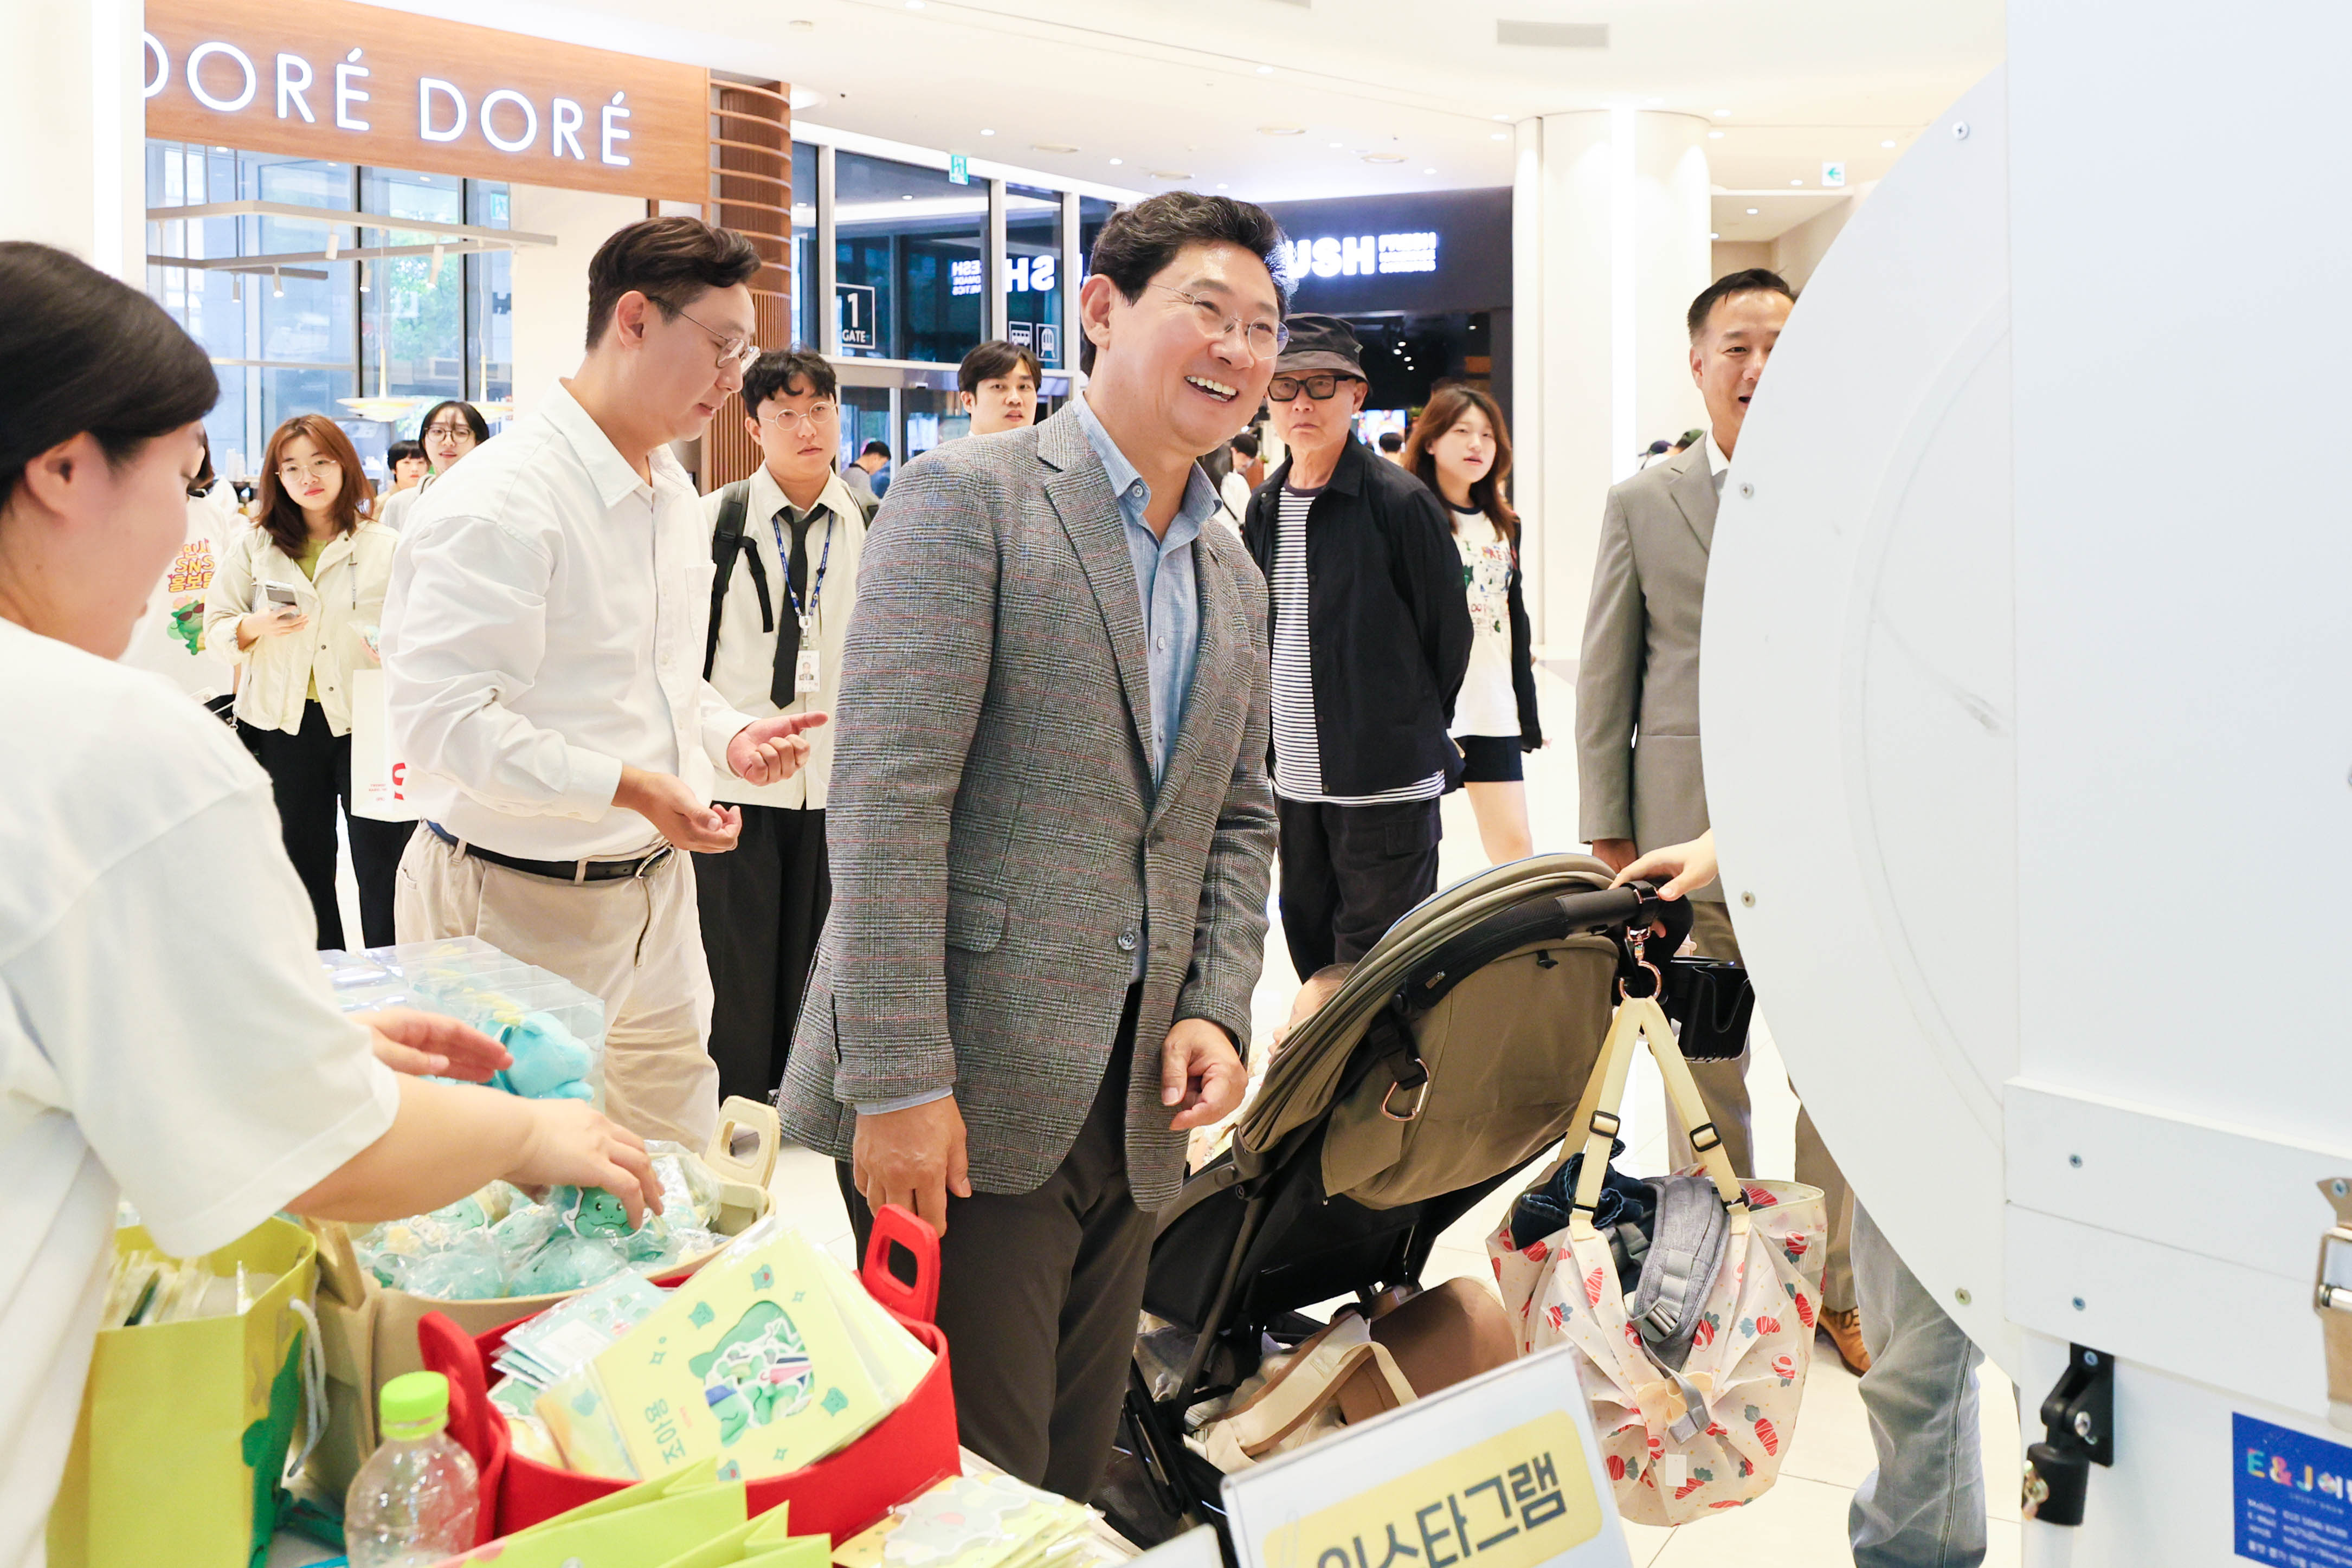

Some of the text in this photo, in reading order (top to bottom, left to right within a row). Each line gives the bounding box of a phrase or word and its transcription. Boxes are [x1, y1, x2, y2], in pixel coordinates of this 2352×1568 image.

[419, 77, 631, 166] DORÉ
[1286, 235, 1375, 279] USH
[847, 293, 858, 328] 1
[842, 329, 866, 343] GATE
[175, 554, 215, 573] SNS
[178, 540, 211, 559] 인시
[645, 1398, 686, 1464] 조아용
